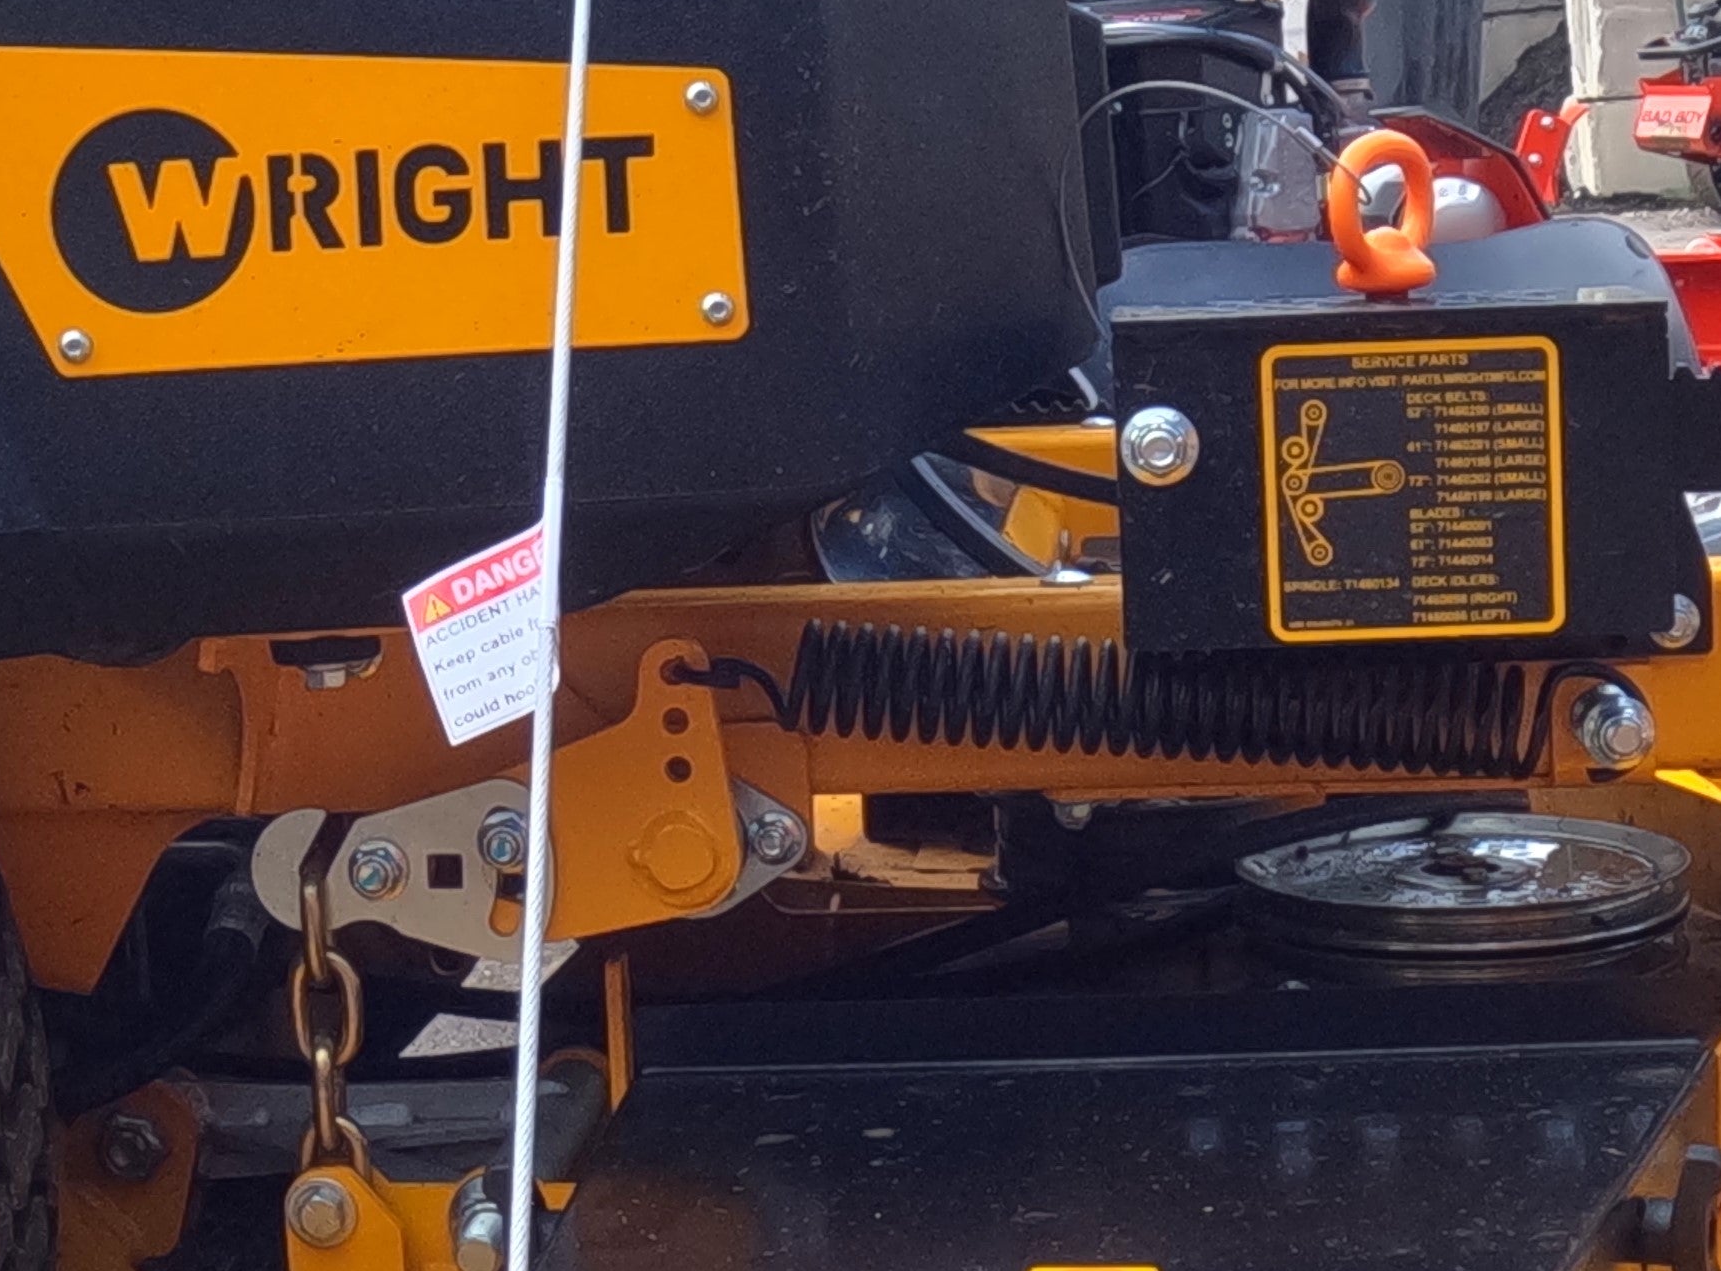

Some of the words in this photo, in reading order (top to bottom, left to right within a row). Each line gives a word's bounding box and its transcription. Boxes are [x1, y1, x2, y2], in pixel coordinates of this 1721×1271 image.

[105, 133, 656, 264] WRIGHT
[1352, 354, 1416, 369] SERVICE
[1419, 353, 1470, 367] PARTS
[450, 539, 545, 605] DANGE
[426, 598, 511, 648] ACCIDENT
[433, 647, 477, 676] Keep
[480, 625, 524, 654] cable
[443, 675, 483, 702] from
[488, 660, 517, 684] any
[453, 693, 502, 728] could
